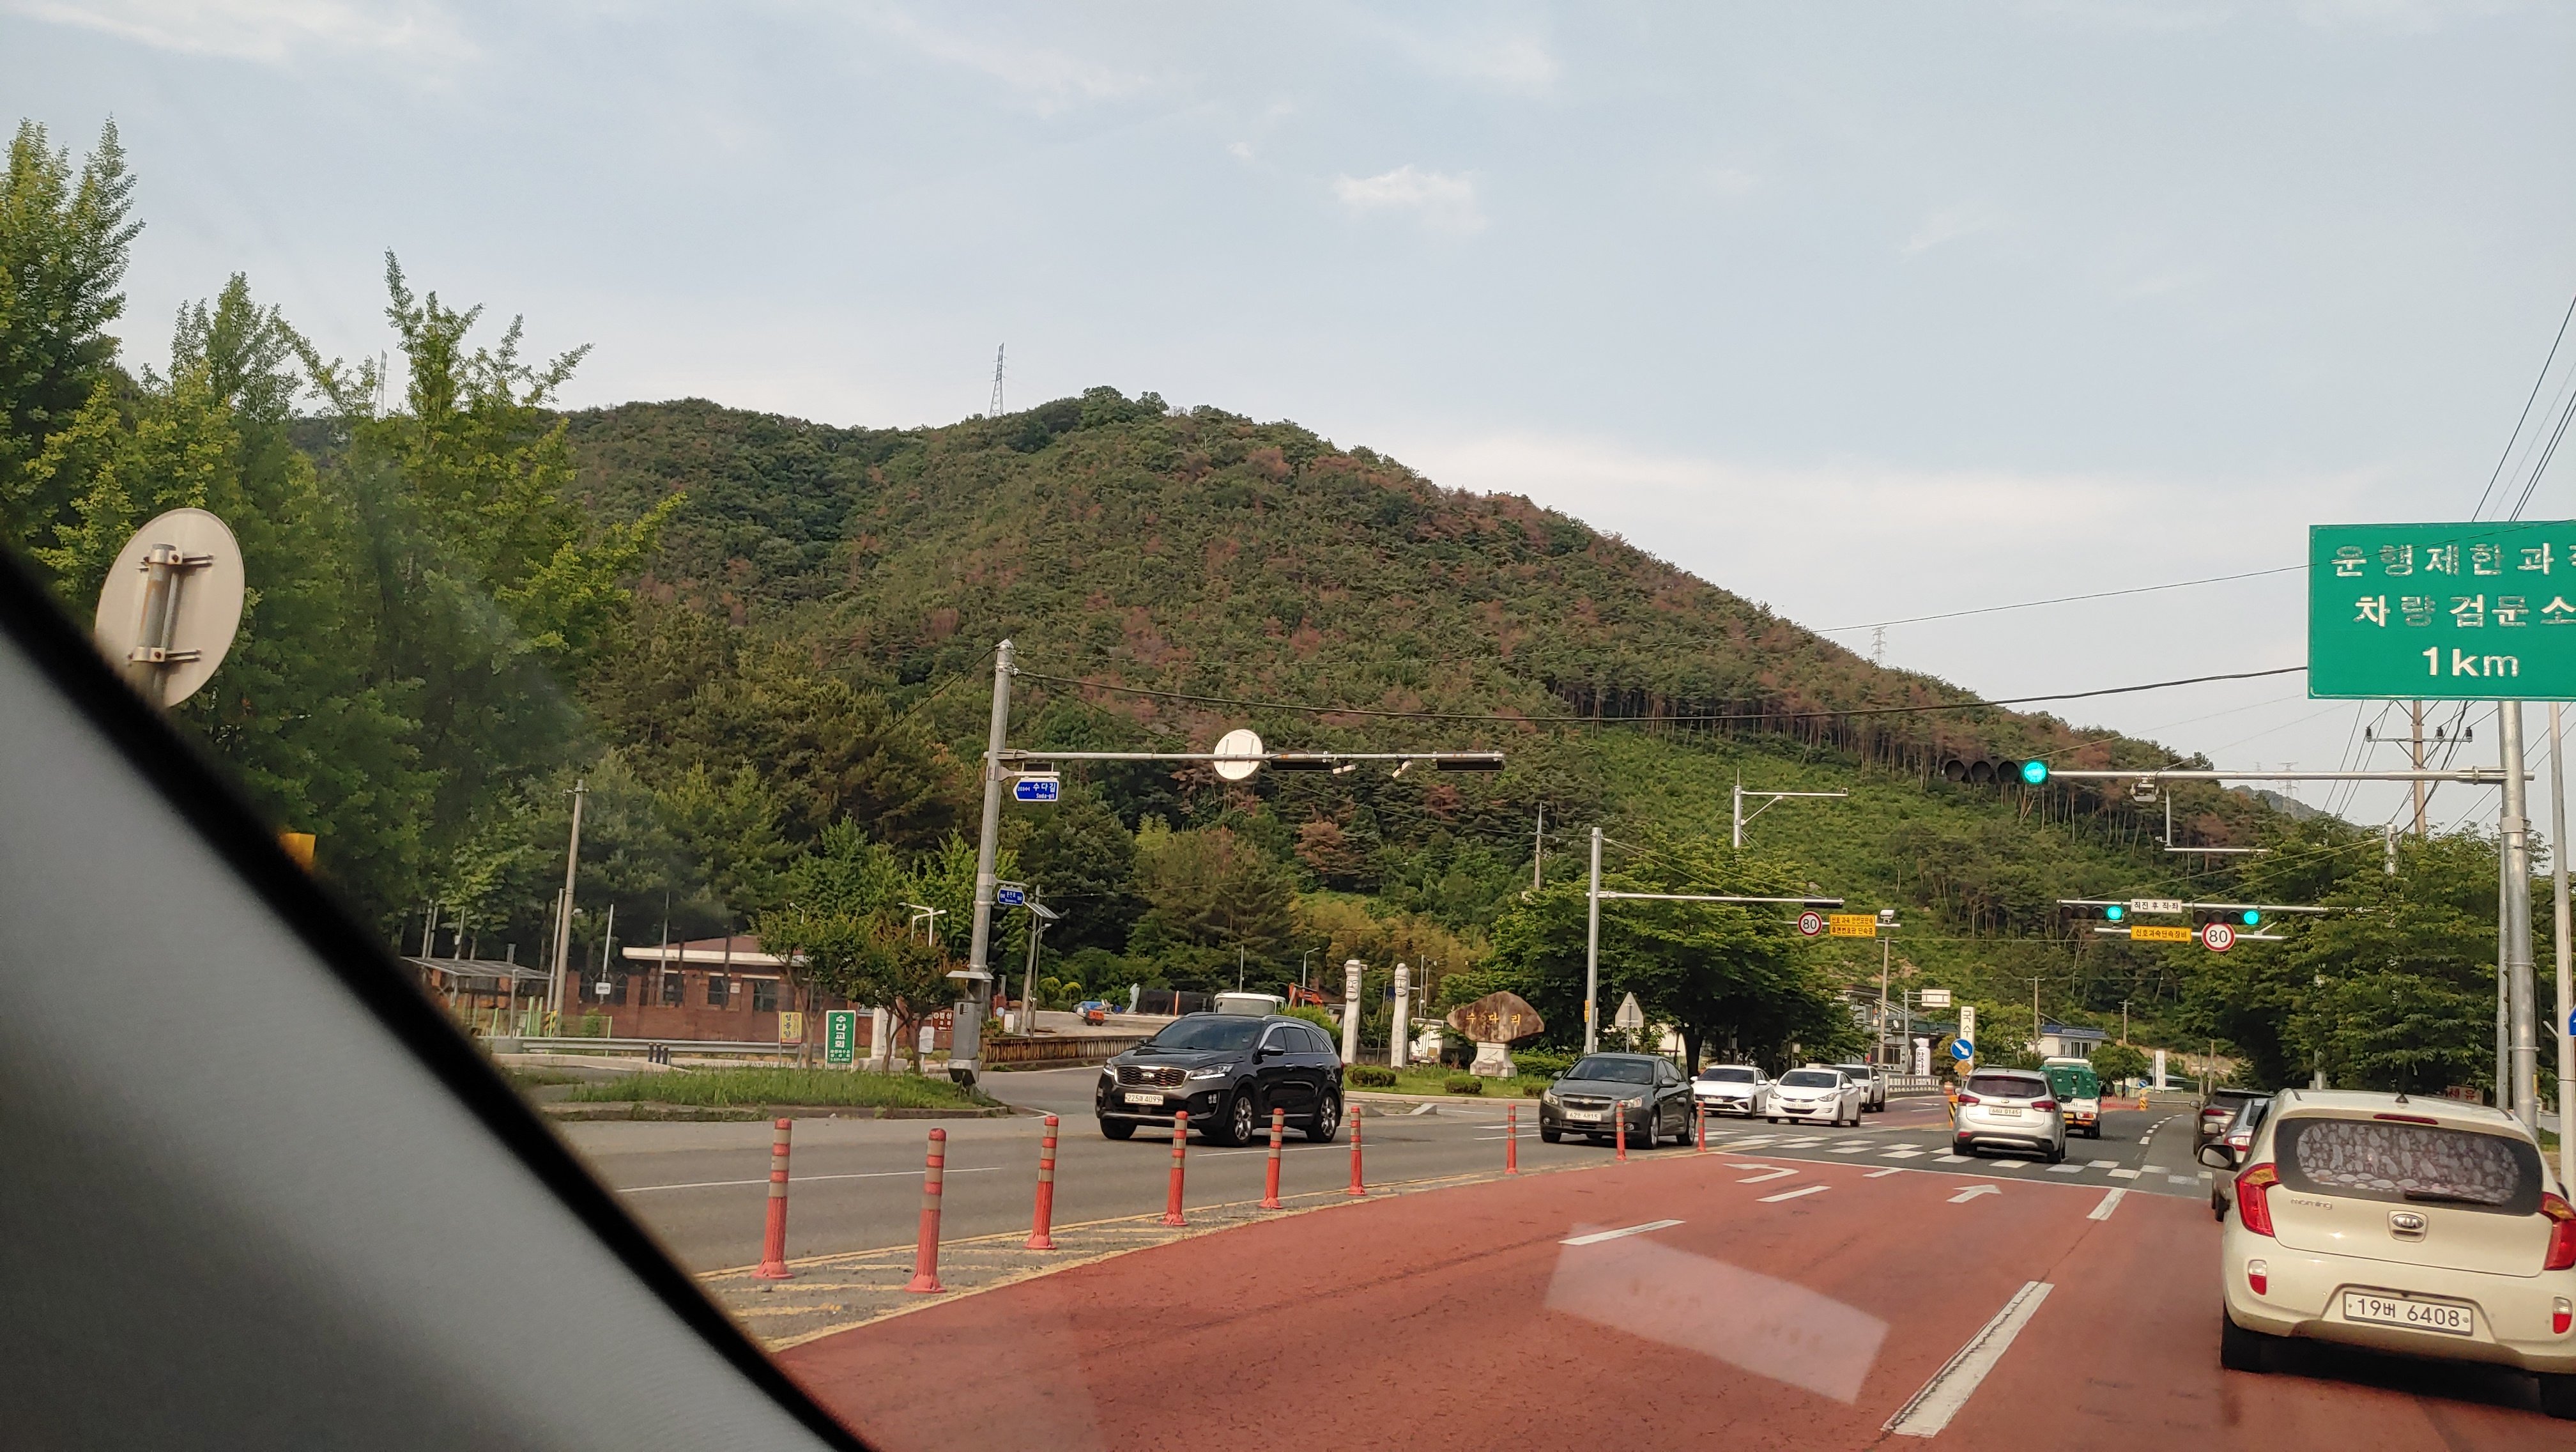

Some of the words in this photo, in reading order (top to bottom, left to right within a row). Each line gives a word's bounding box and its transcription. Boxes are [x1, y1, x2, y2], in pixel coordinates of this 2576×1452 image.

[2331, 542, 2576, 577] 운행제한과
[1033, 783, 1056, 793] 수다길
[2134, 901, 2149, 910] 직진
[2152, 902, 2159, 910] 후
[1802, 918, 1817, 929] 80
[2135, 928, 2187, 939] 신호과속단속장비
[2209, 930, 2228, 943] 80
[1466, 1012, 1521, 1026] 수다리
[1963, 1010, 1972, 1037] 국수
[2290, 1198, 2333, 1210] morning
[2394, 1215, 2421, 1228] KIA
[2407, 1304, 2460, 1327] 6408
